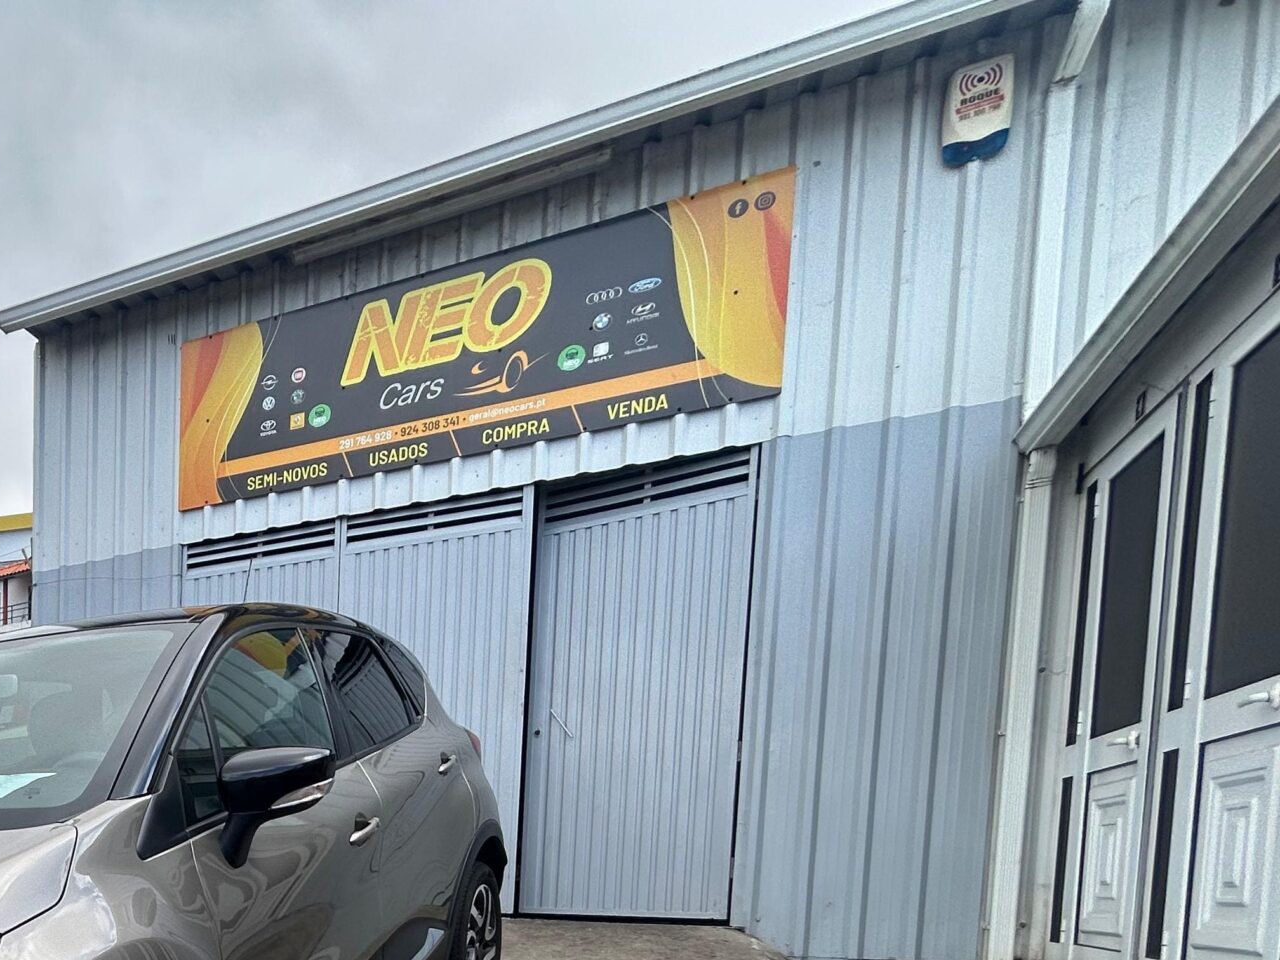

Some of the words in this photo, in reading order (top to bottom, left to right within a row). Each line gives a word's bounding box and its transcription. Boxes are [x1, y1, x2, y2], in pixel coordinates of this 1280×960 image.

[340, 258, 552, 387] NEO
[379, 378, 445, 410] Cars
[607, 393, 669, 420] VENDA
[339, 438, 354, 450] 291
[374, 430, 392, 441] 928
[400, 424, 419, 437] 924
[422, 420, 440, 433] 308
[443, 415, 460, 428] 341
[469, 398, 547, 424] geral@neocars.pt
[482, 417, 550, 445] COMPRA
[369, 442, 429, 467] USADOS
[247, 462, 328, 491] SEMI-NOVOS
